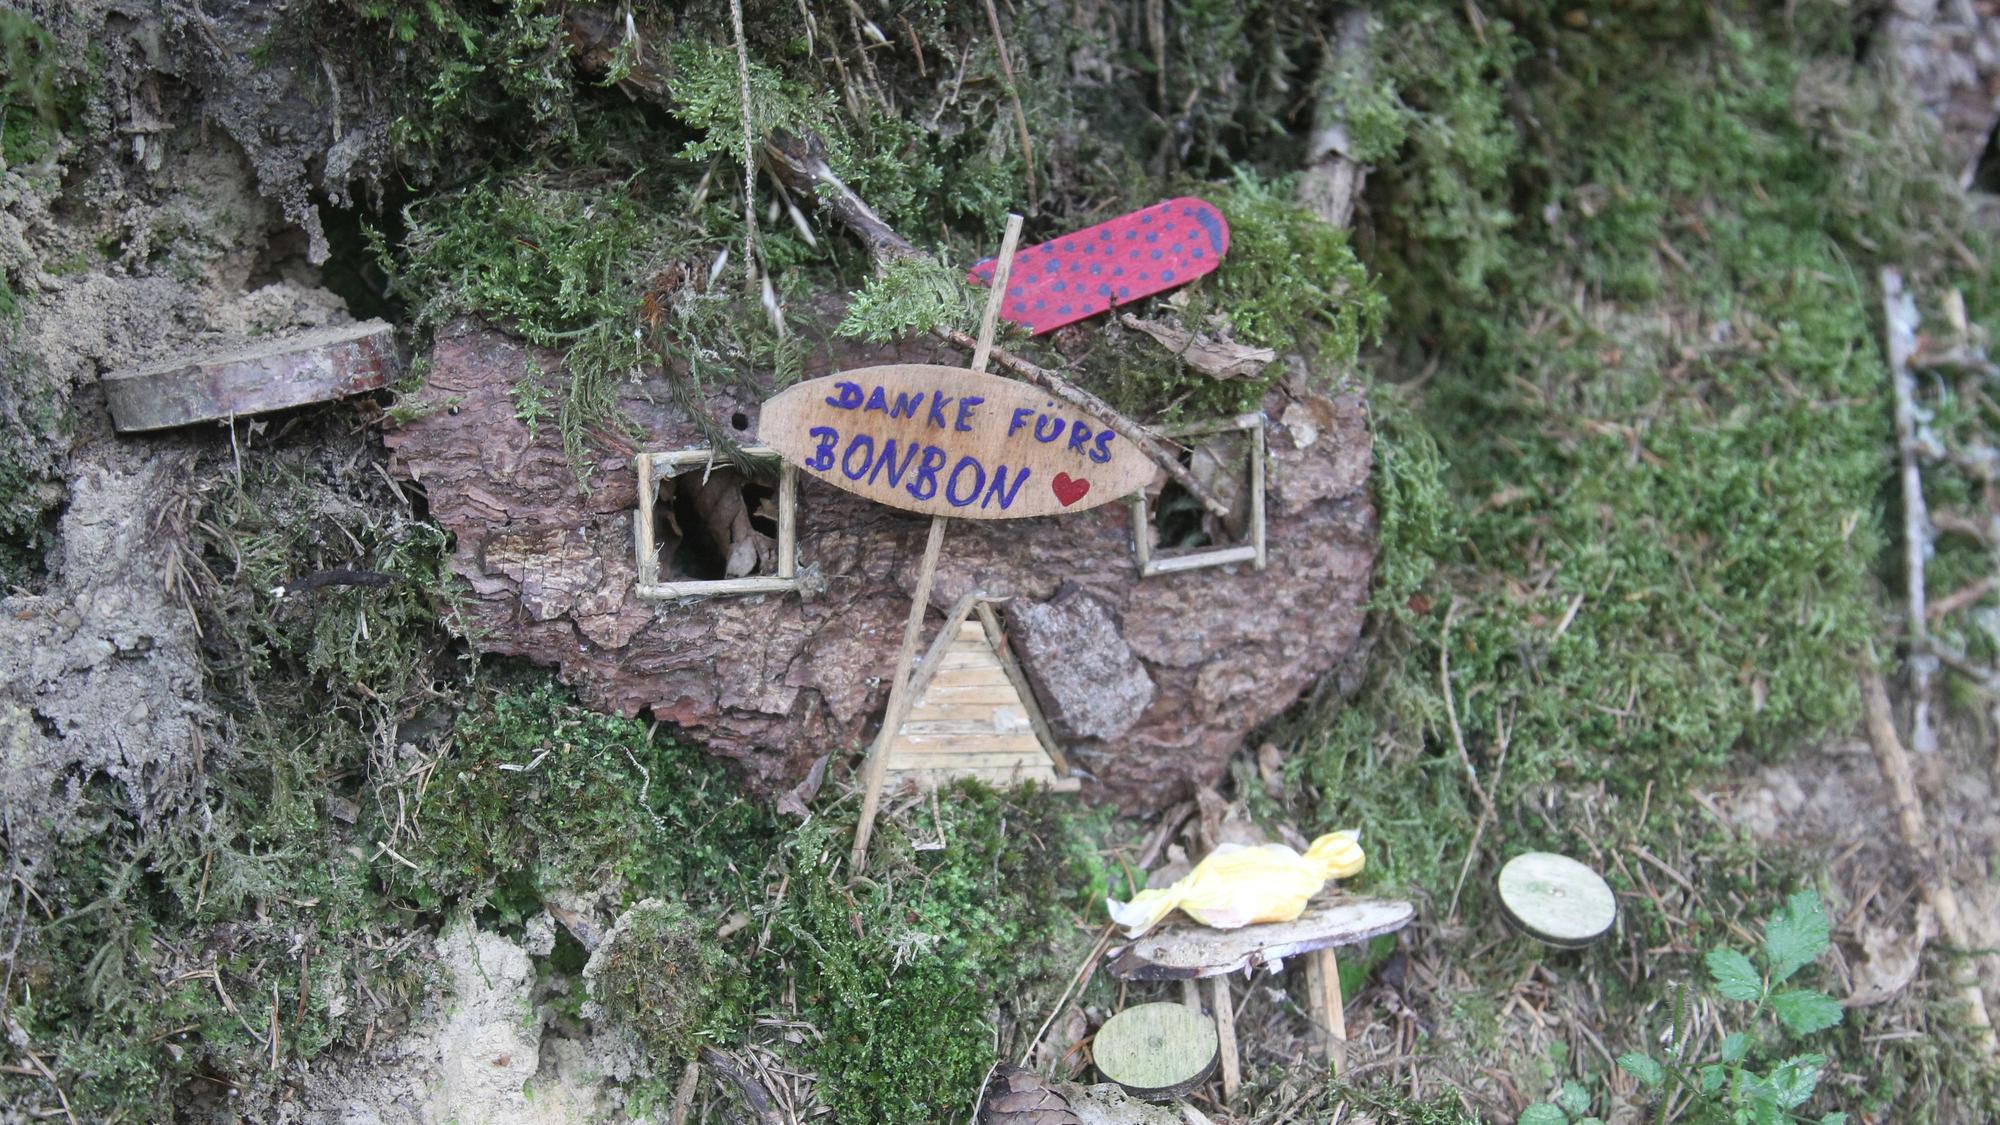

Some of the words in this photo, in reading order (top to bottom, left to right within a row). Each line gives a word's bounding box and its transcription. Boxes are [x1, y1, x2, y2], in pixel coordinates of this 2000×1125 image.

[825, 380, 986, 432] DANKE
[1007, 401, 1116, 464] FÜRS
[804, 426, 1032, 511] BONBON
